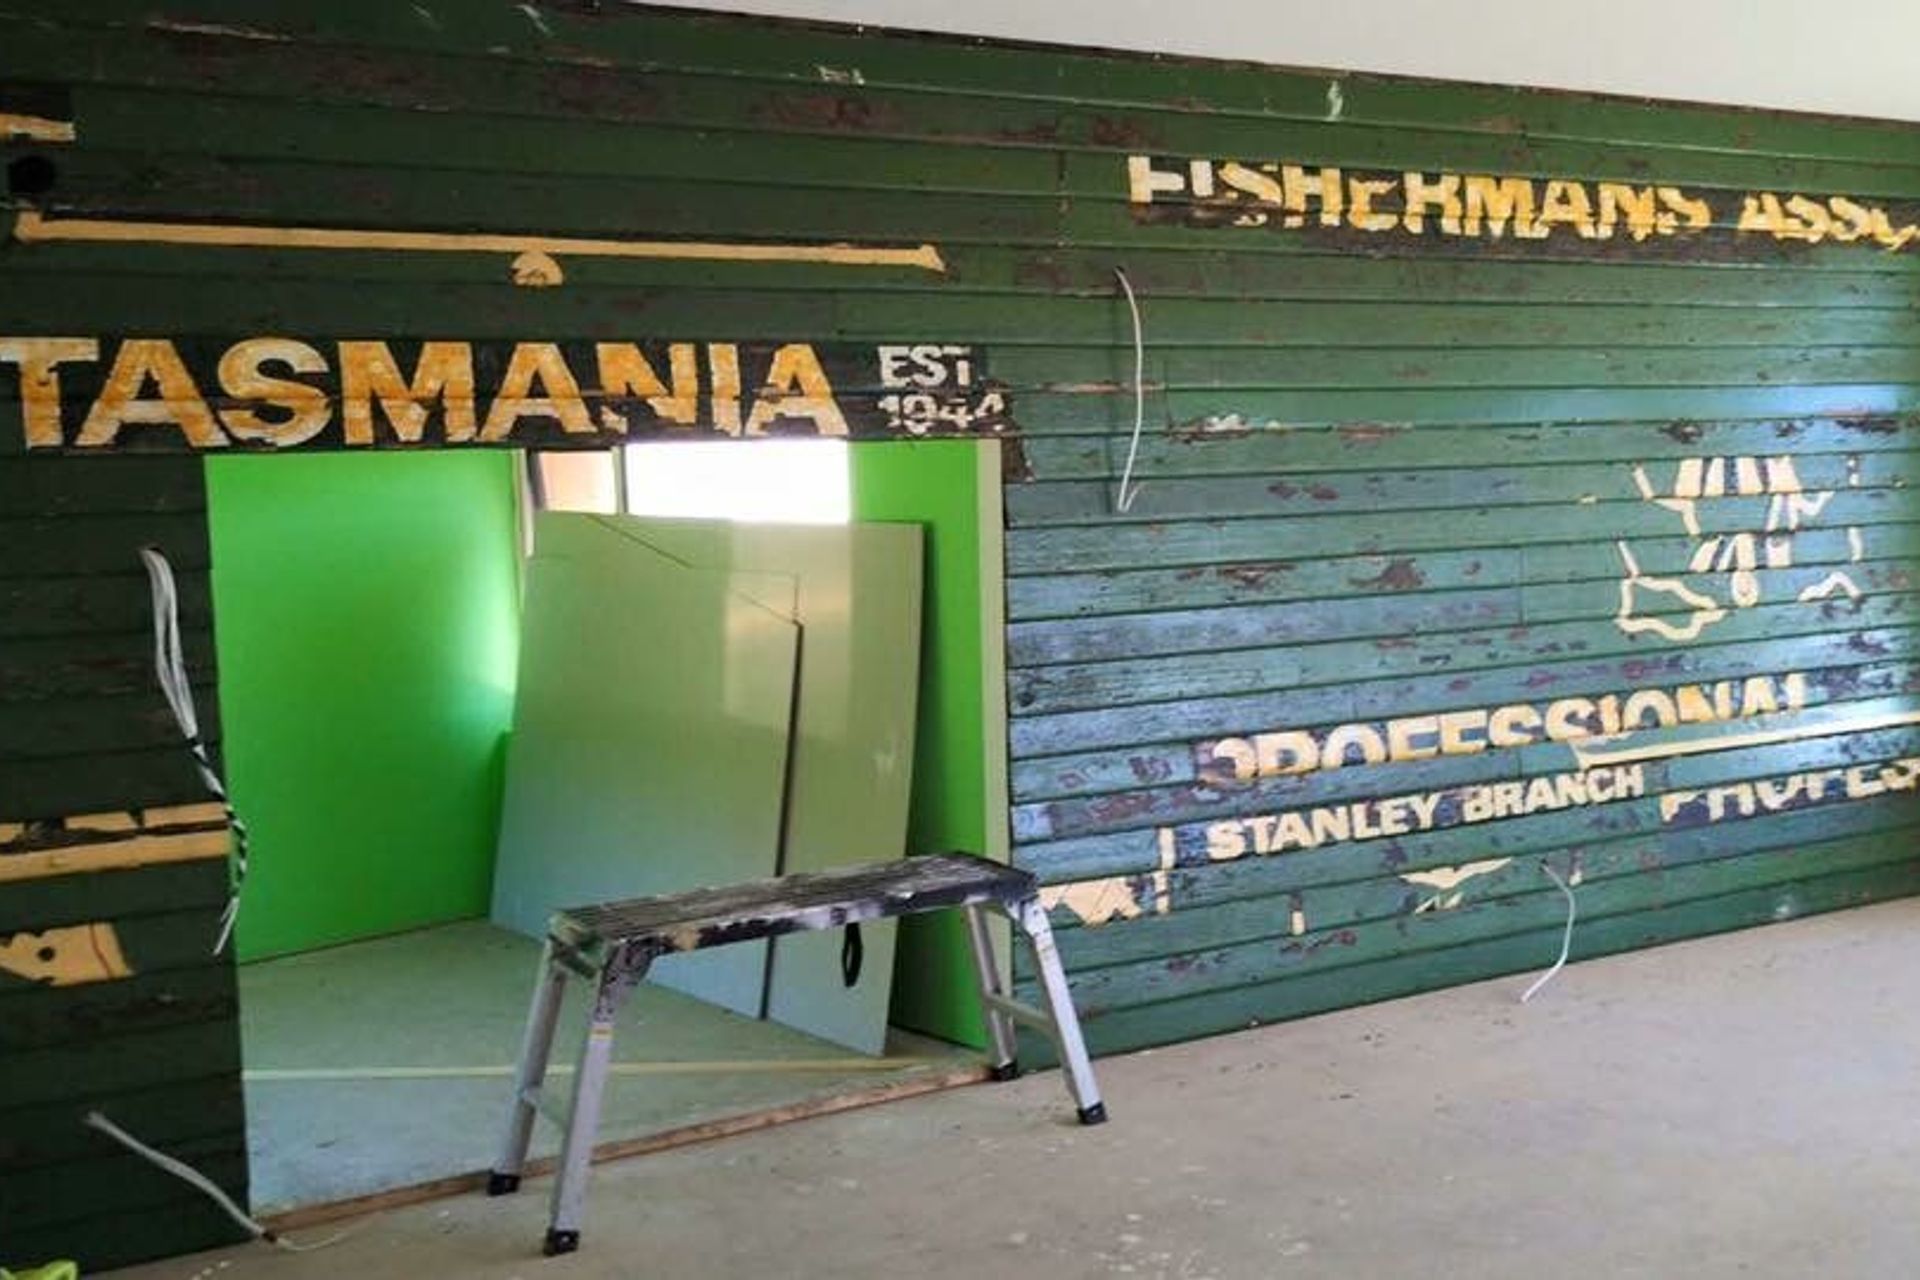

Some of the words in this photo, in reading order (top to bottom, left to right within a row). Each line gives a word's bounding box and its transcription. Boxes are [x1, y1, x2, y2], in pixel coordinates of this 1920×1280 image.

[0, 337, 850, 448] TASMANIA
[878, 345, 972, 388] EST
[1207, 792, 1441, 860] STANLEY
[1463, 764, 1645, 823] BRANCH
